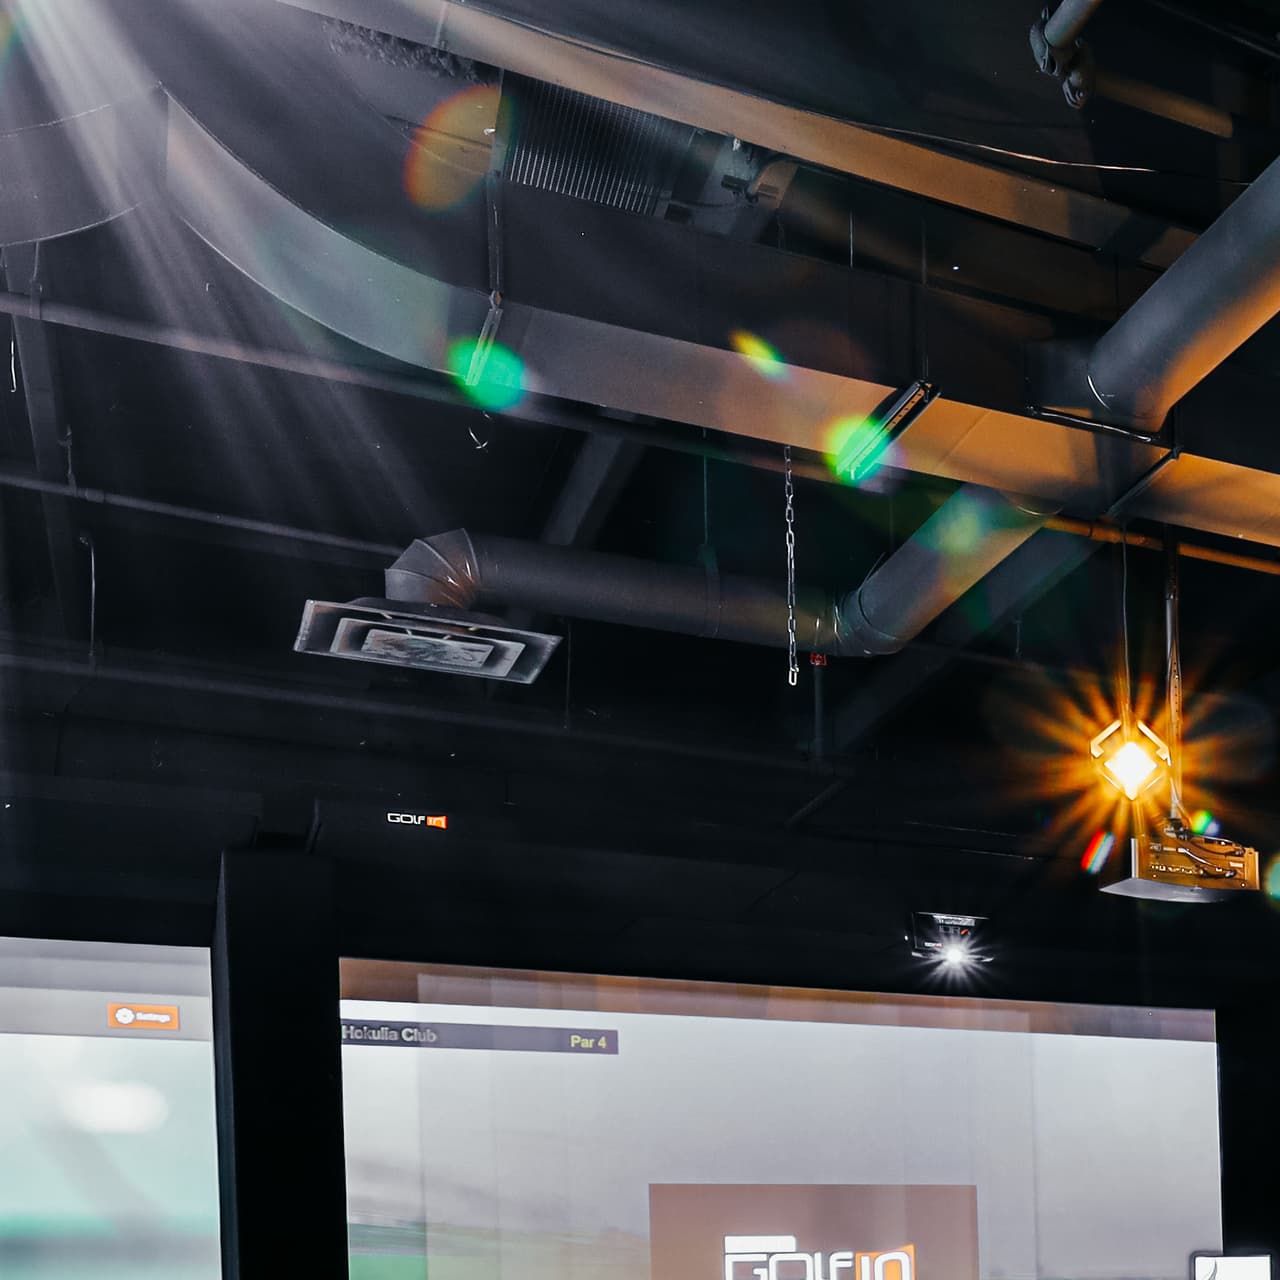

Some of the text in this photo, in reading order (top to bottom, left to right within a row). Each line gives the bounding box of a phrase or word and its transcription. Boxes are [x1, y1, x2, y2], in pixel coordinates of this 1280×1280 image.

[401, 1027, 437, 1043] Club
[570, 1035, 607, 1048] Par 4
